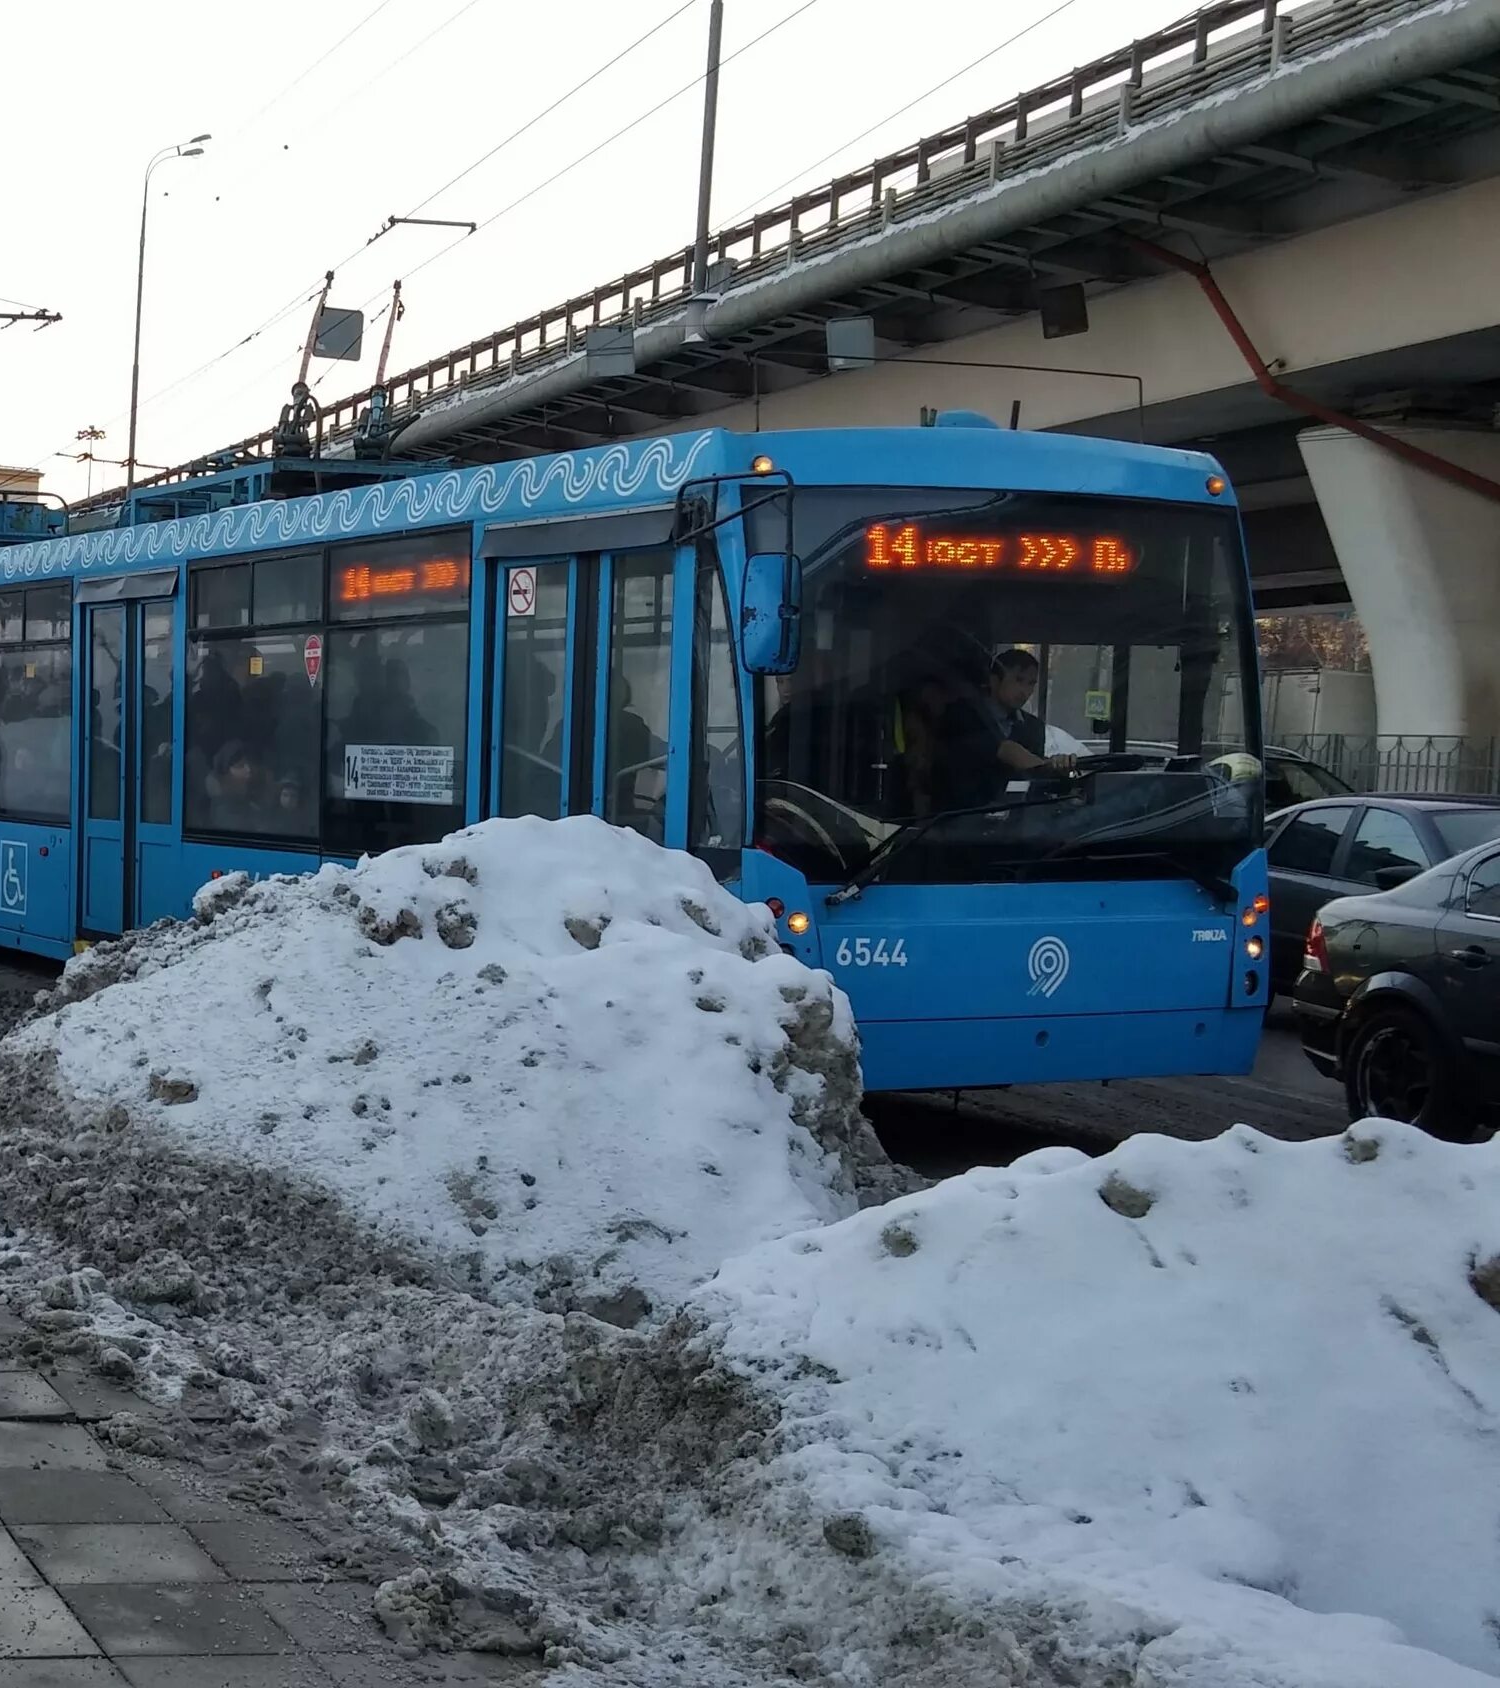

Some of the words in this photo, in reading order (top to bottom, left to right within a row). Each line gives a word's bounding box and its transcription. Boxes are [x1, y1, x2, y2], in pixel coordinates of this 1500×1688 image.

[867, 526, 916, 565] 14
[346, 755, 359, 790] 14
[835, 937, 909, 967] 6544
